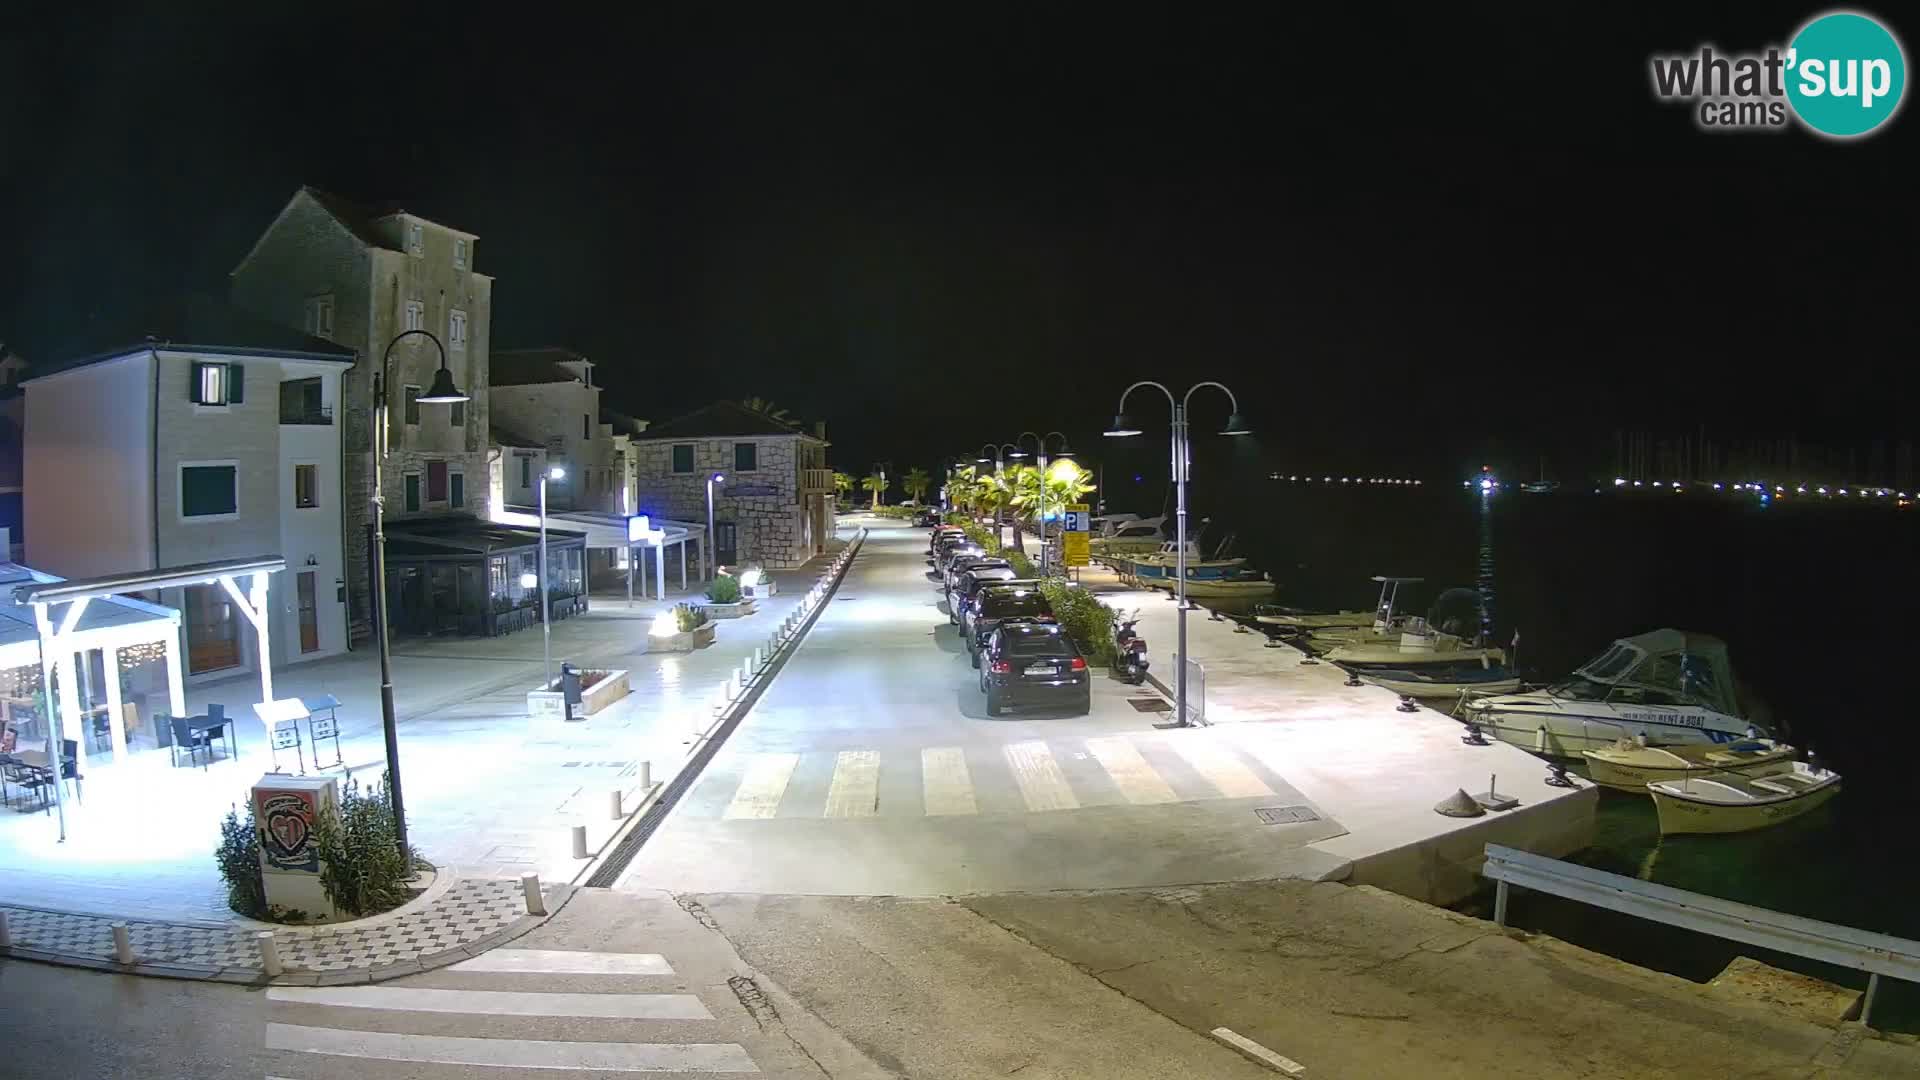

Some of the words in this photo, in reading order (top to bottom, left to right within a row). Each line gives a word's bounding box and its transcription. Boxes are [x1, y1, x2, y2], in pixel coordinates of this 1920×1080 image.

[1066, 513, 1076, 530] P
[1658, 713, 1679, 725] RENT
[1680, 715, 1685, 725] A
[1686, 715, 1705, 729] BOAT
